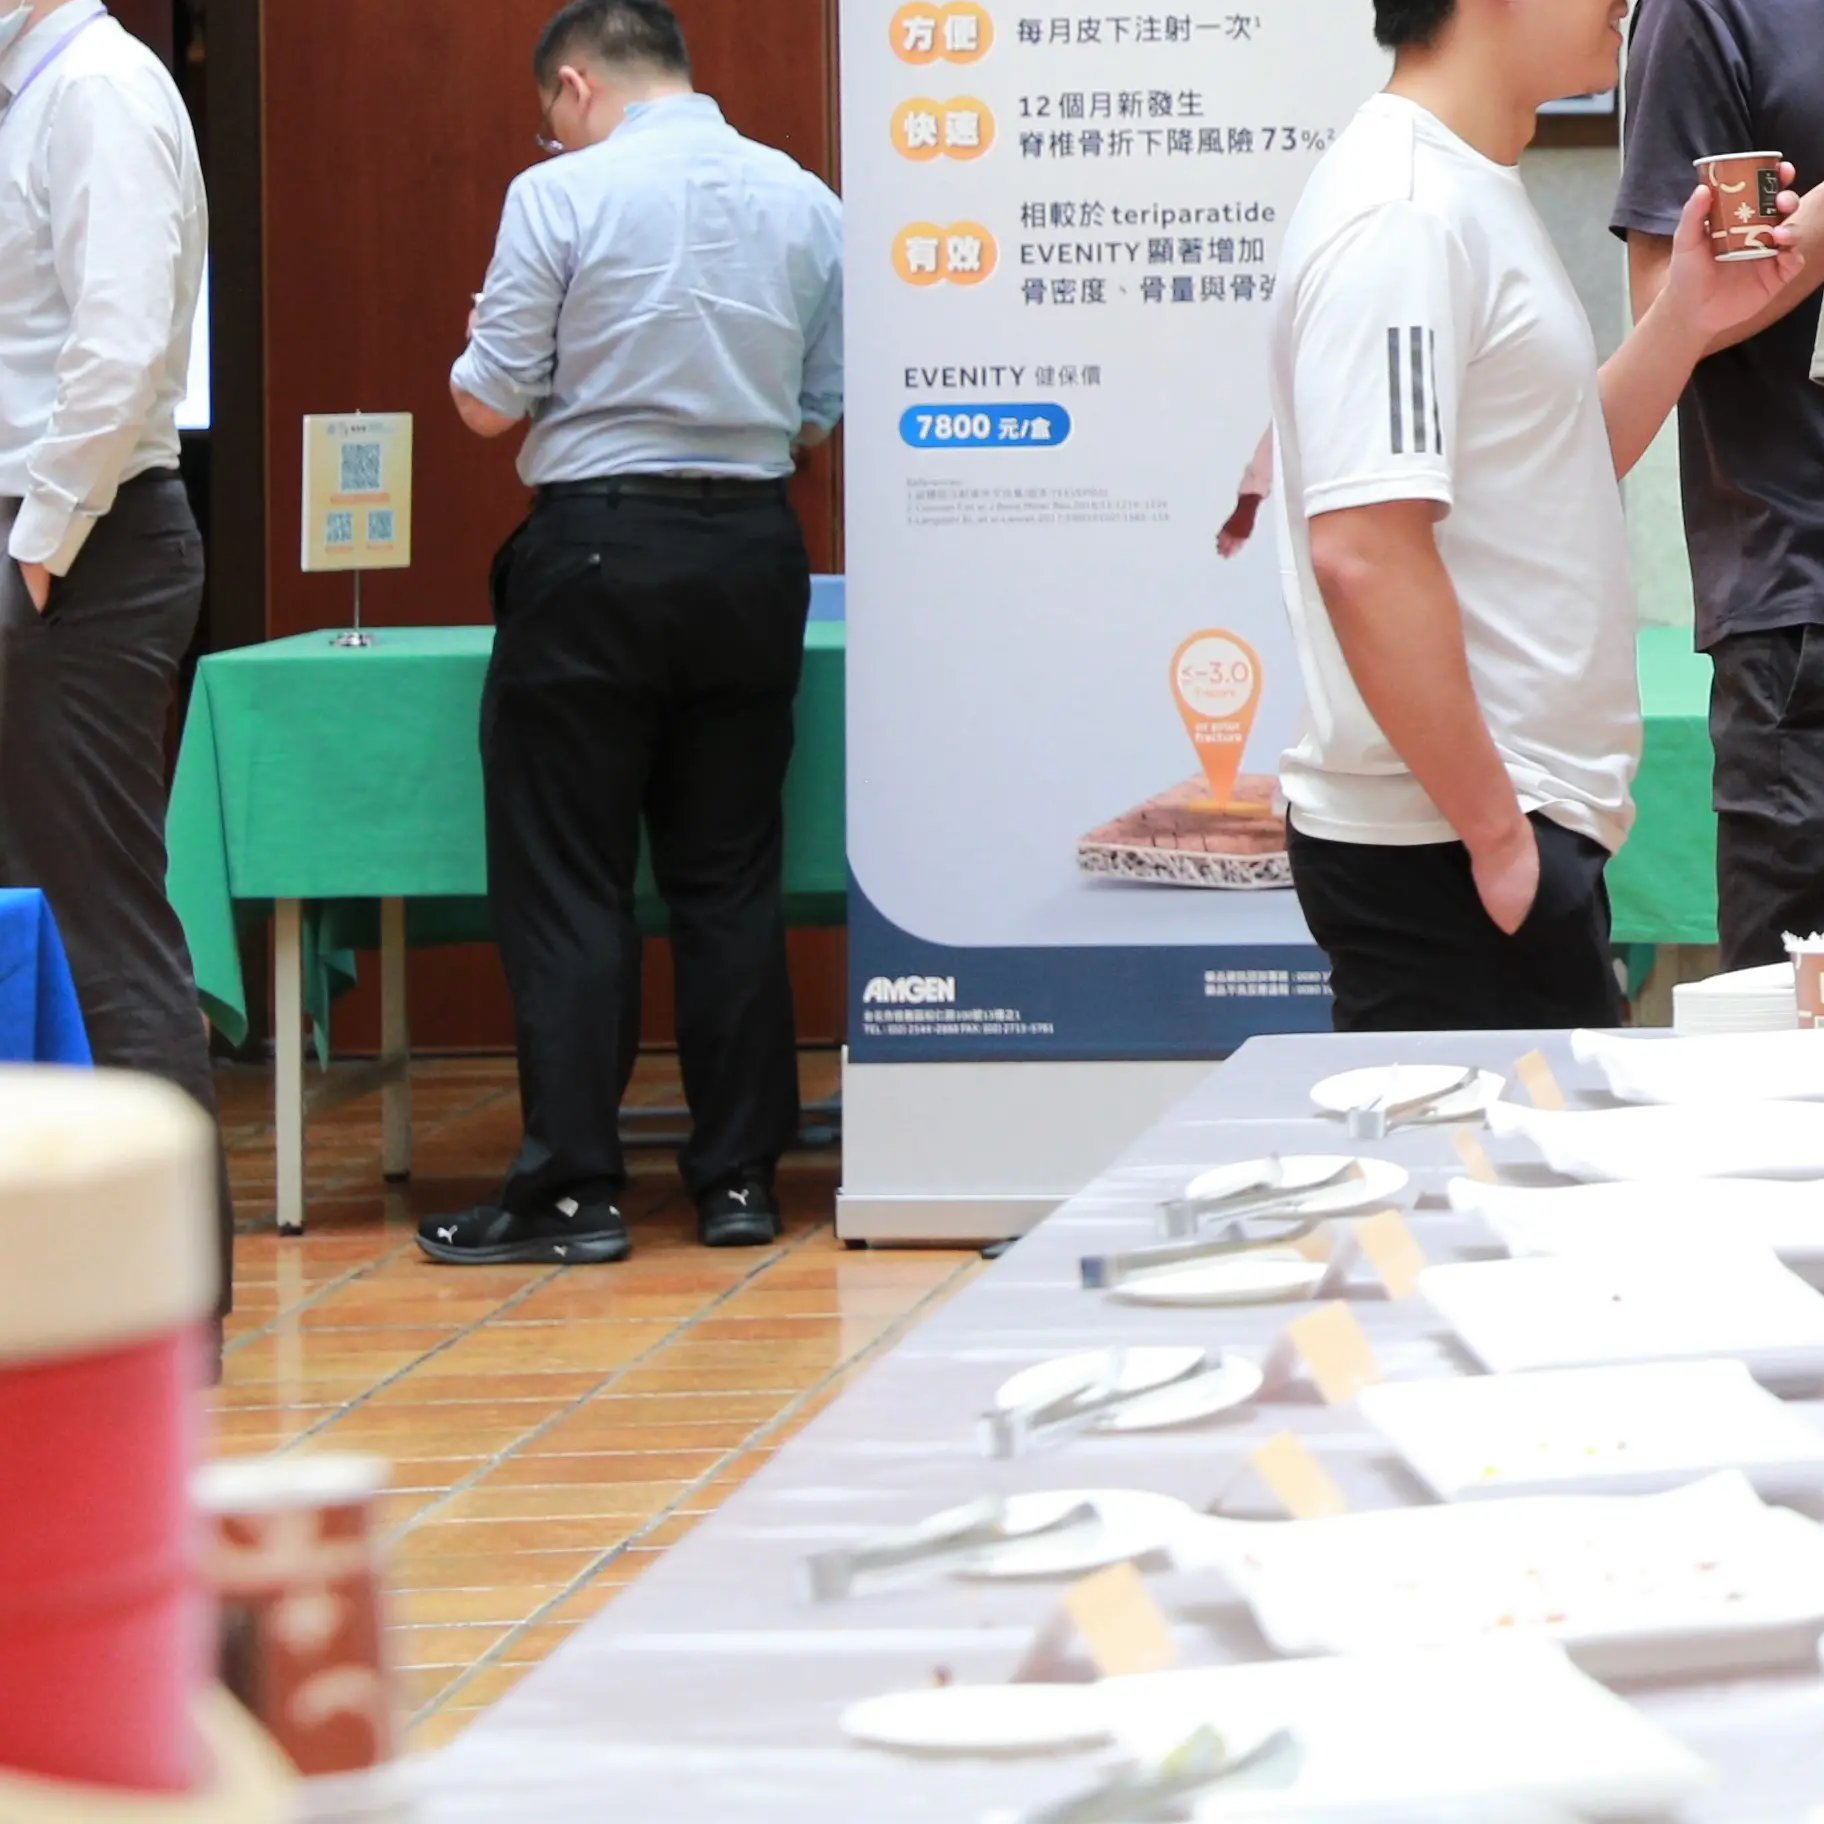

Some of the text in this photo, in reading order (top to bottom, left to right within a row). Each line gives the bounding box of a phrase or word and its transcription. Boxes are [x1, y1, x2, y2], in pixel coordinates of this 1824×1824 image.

[902, 15, 979, 52] 方便
[1019, 90, 1204, 119] 12 個月新發生
[903, 111, 981, 149] 快速
[1018, 128, 1254, 160] 脊椎骨折下降風險
[1019, 200, 1276, 229] 相較於 teriparatide
[905, 236, 1265, 273] 有效 EVENITY 顯著增加
[904, 365, 1102, 389] EVENITY 健保價
[916, 413, 991, 440] 7800
[863, 976, 955, 1003] AMGEN
